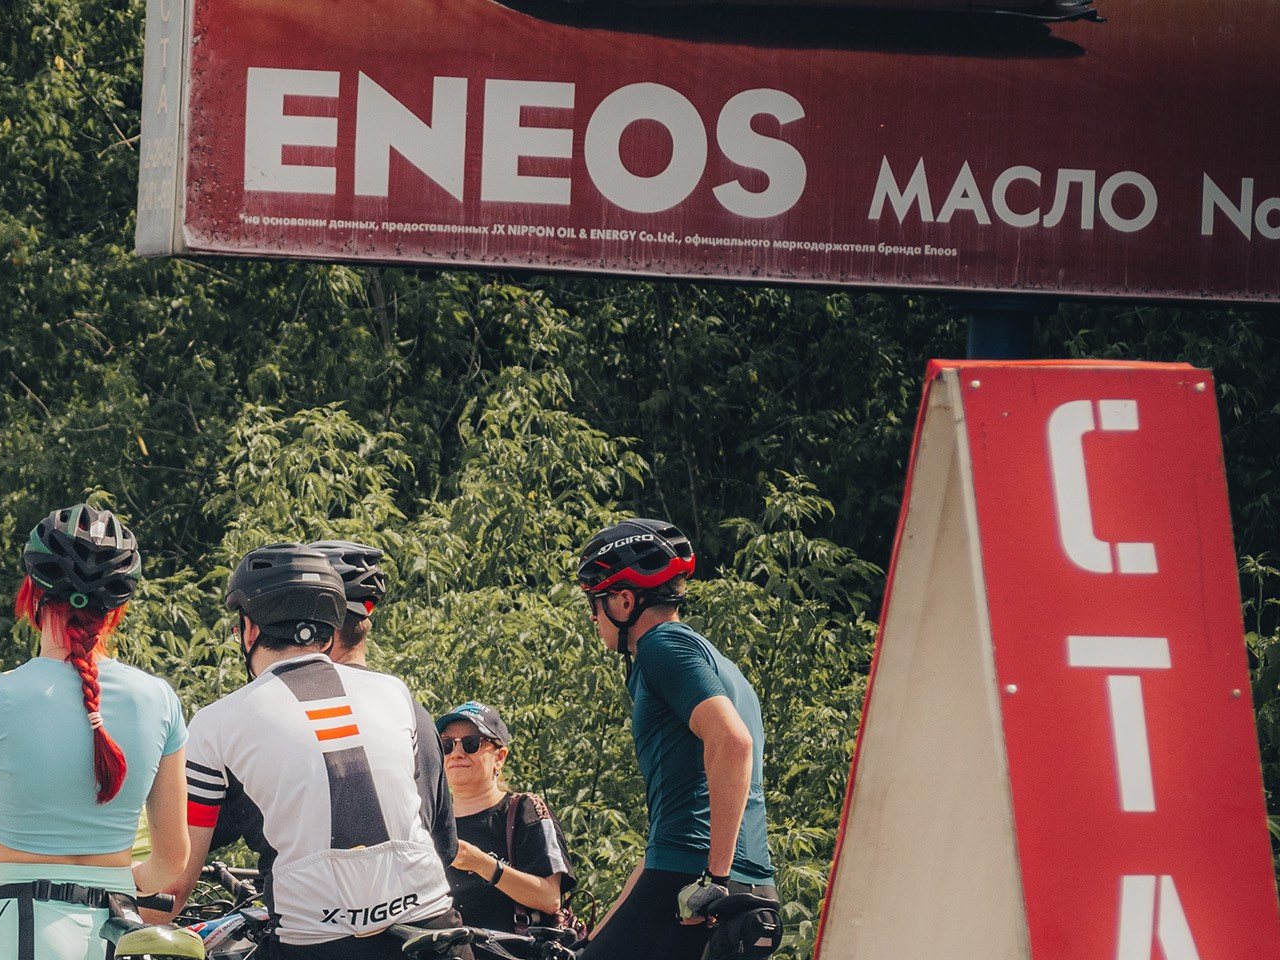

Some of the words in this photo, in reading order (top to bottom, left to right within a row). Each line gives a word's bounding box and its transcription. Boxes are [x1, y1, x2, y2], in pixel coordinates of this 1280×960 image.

[244, 67, 807, 219] ENEOS
[867, 154, 1158, 233] МАСЛО
[262, 215, 327, 228] основании
[328, 218, 380, 231] данных,
[381, 220, 489, 235] предоставленных
[491, 223, 506, 236] JX
[507, 224, 556, 238] NIPPON
[557, 226, 577, 239] OIL
[578, 227, 588, 239] &
[590, 228, 637, 242] ENERGY
[684, 233, 771, 249] официального
[773, 238, 876, 253] маркодержателя
[877, 242, 922, 257] бренда
[924, 243, 958, 257] Eneos
[614, 533, 654, 548] GIRO
[320, 893, 420, 926] X-TIGER
